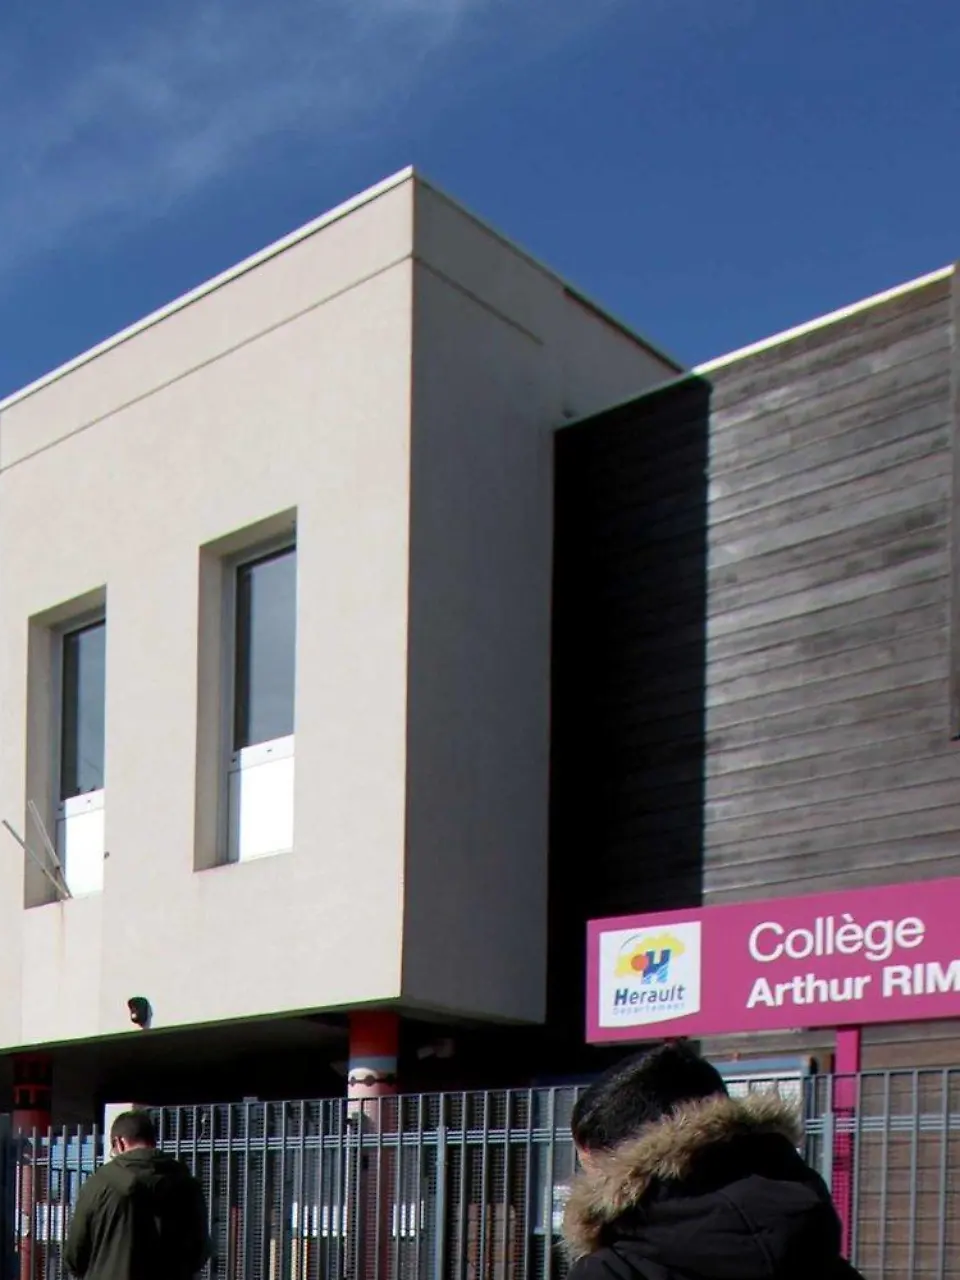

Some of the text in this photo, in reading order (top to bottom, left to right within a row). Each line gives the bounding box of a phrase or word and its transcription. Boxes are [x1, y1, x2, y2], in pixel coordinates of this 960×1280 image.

[748, 913, 926, 962] Collège
[746, 959, 960, 1008] Arthur RIM
